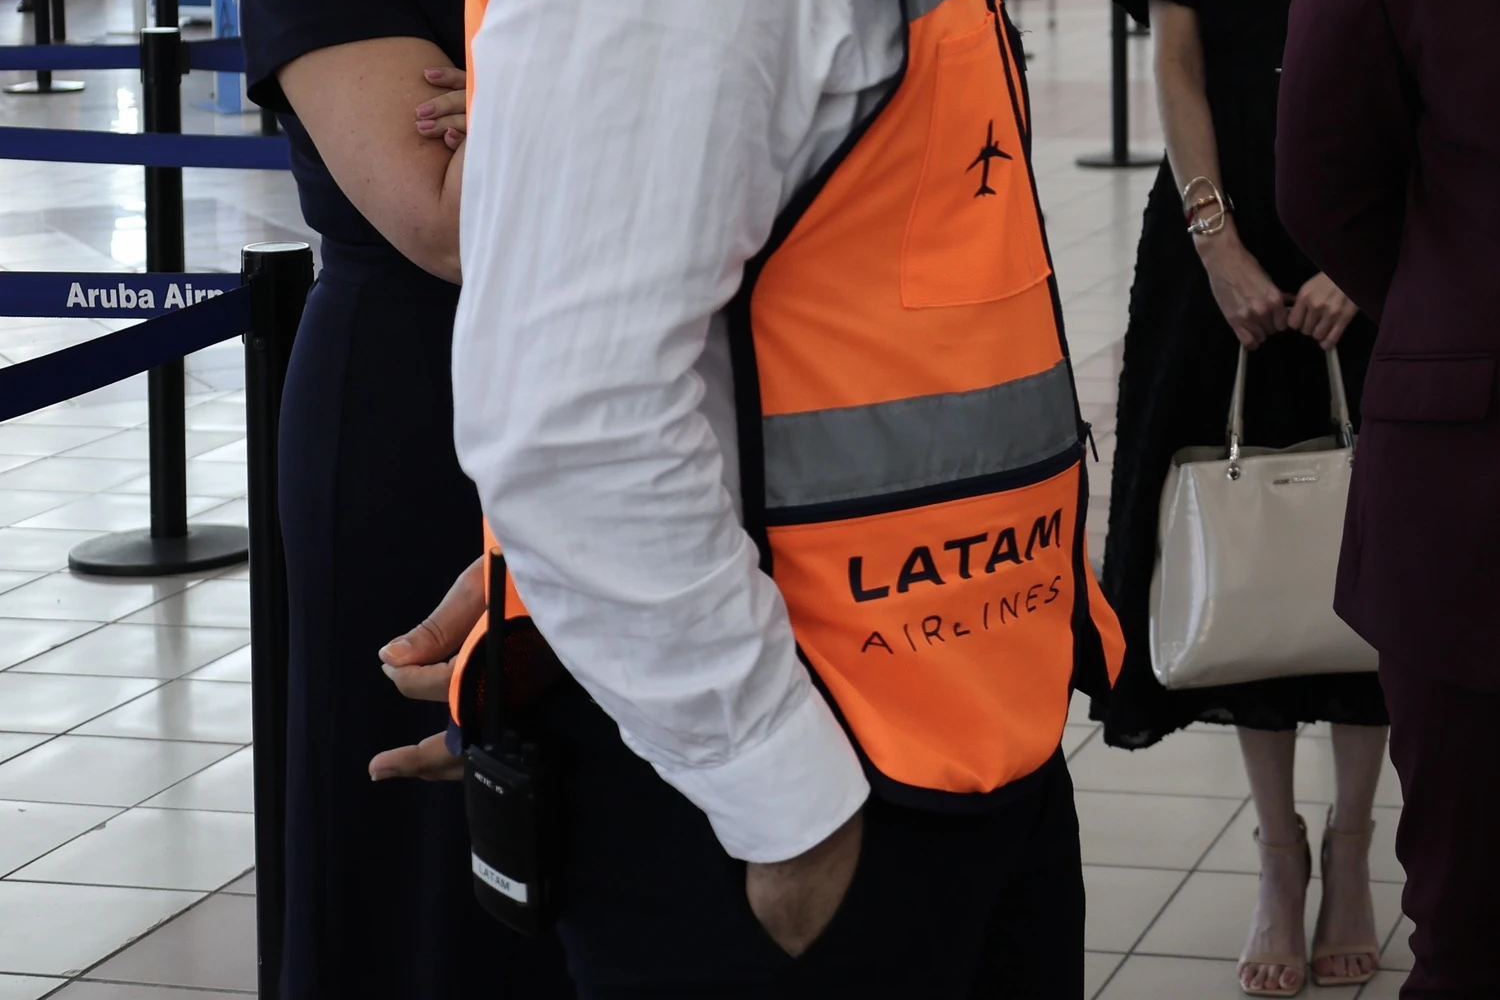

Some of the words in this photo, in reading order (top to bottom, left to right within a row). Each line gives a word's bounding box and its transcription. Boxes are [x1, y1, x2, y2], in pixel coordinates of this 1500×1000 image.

[66, 281, 155, 309] Aruba
[848, 508, 1063, 603] LATAM
[478, 862, 511, 892] LATAM
